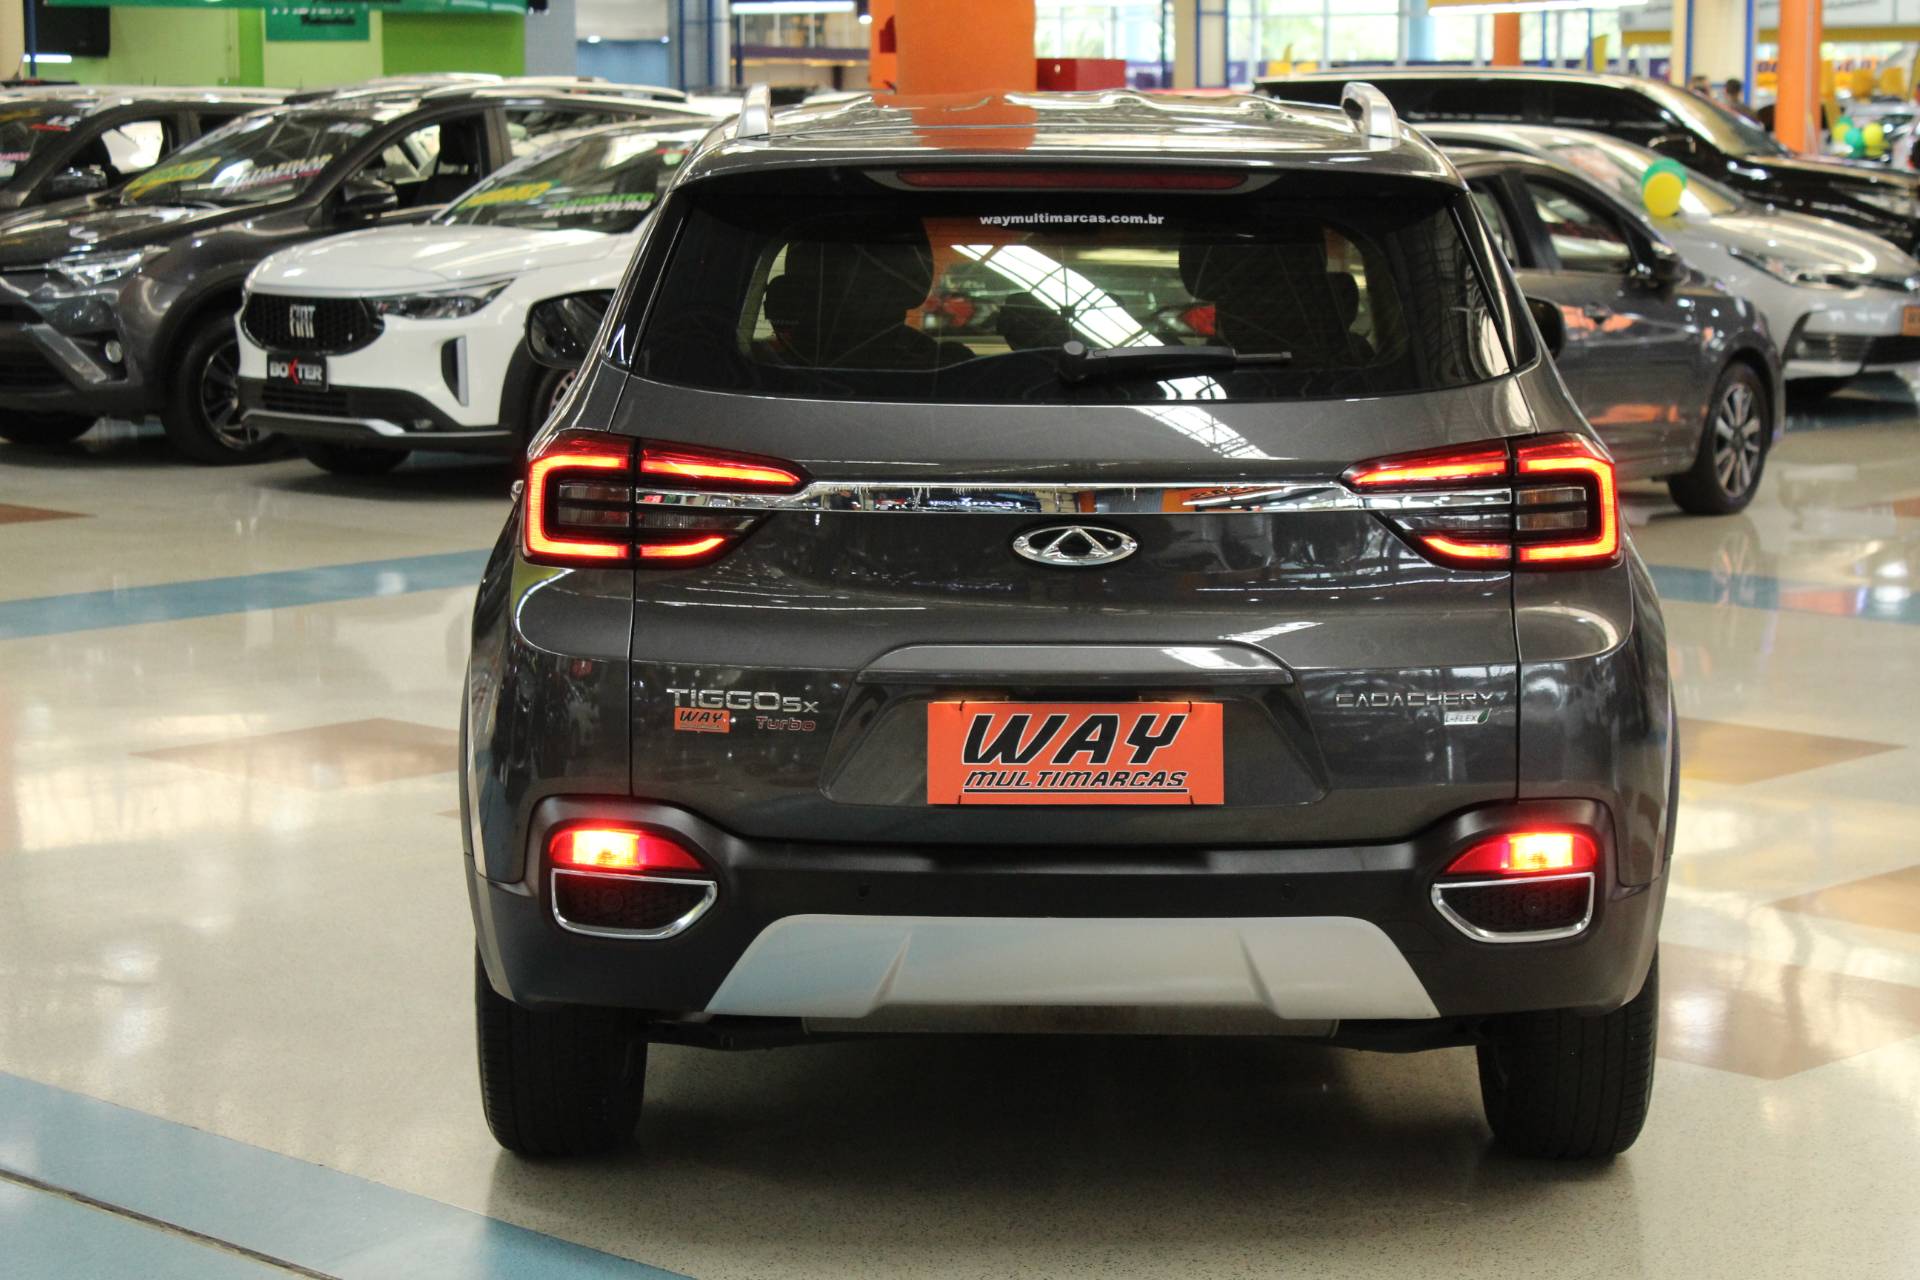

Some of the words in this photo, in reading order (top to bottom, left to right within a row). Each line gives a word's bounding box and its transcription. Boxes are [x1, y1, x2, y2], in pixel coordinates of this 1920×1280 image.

[980, 213, 1165, 227] waymultimarcas.com.br
[289, 304, 316, 338] FIAT
[679, 710, 724, 723] WAY
[756, 716, 817, 732] Turbo
[962, 713, 1189, 765] WAY
[964, 770, 1189, 788] MULTIMARCAS
